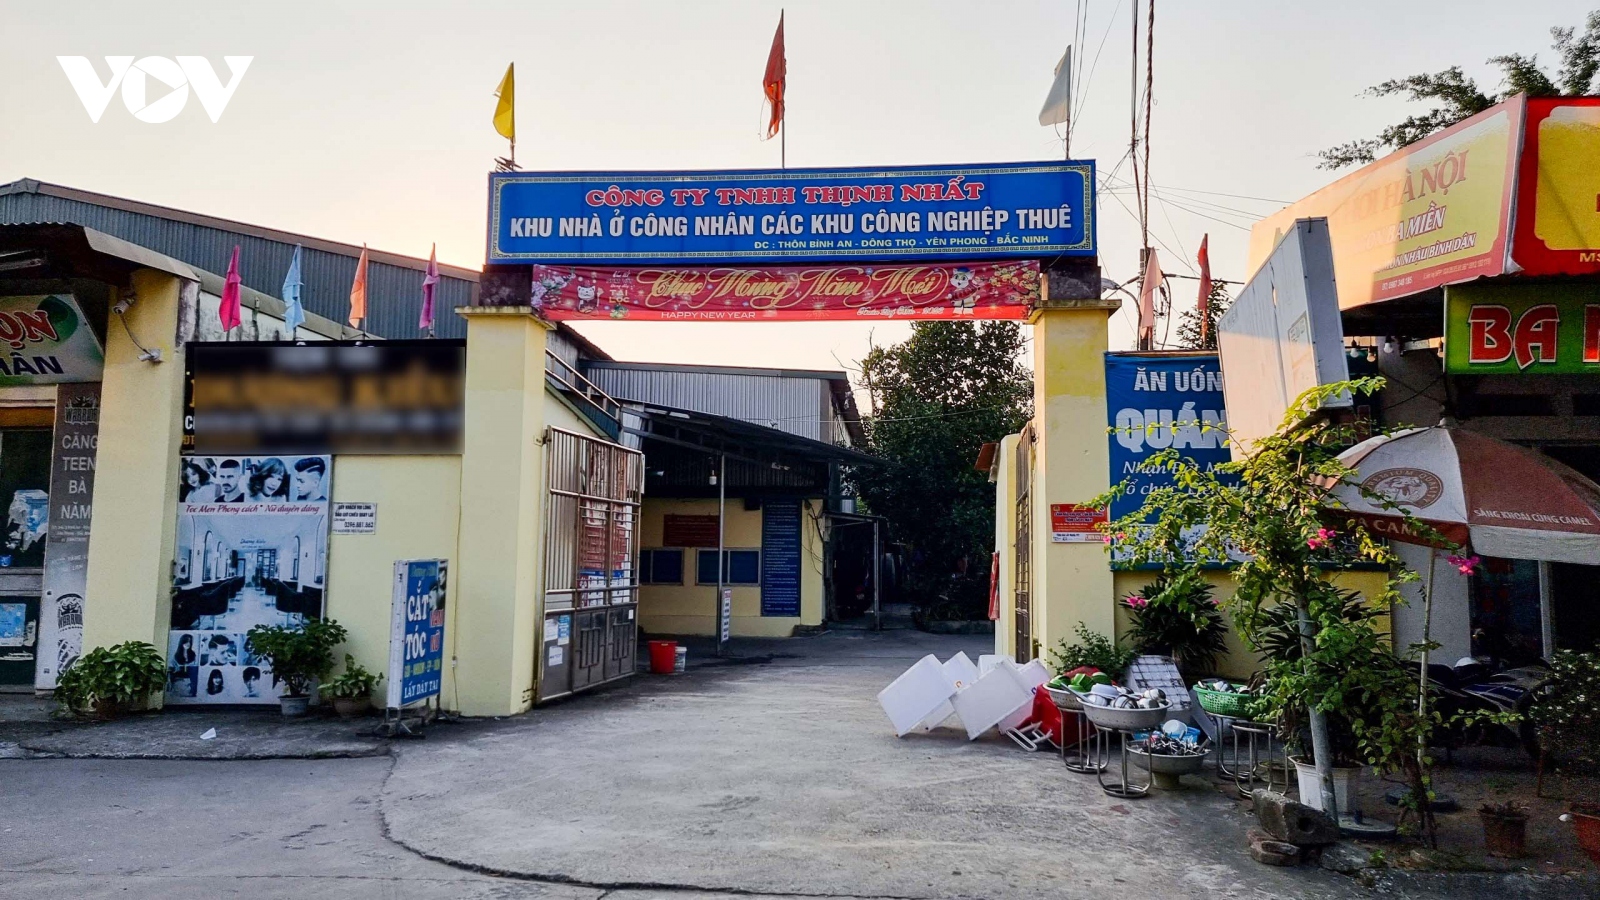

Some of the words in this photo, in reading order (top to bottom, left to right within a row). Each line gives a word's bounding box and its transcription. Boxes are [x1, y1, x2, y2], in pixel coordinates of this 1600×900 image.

[1418, 149, 1470, 199] NỘI
[586, 184, 665, 207] CÔNG
[671, 189, 709, 206] TY
[716, 187, 796, 206] TNHH
[802, 186, 894, 206] THỊNH
[901, 175, 984, 201] NHẤT
[510, 217, 552, 237] KHU
[559, 212, 602, 237] NHÀ
[610, 209, 625, 236] Ở
[630, 212, 687, 236] CÔNG
[695, 211, 754, 236] NHÂN
[761, 211, 804, 236] CÁC
[811, 213, 854, 235] KHU
[862, 209, 920, 234] CÔNG
[928, 206, 1008, 234] NGHIỆP
[1016, 204, 1072, 229] THUÊ
[1404, 200, 1446, 240] MIỀN
[778, 239, 806, 249] THÔN
[809, 239, 834, 249] BÌNH
[837, 240, 852, 248] AN
[895, 239, 916, 248] THỌ
[925, 237, 946, 247] YÊN
[950, 237, 988, 247] PHONG
[997, 235, 1019, 245] BẮC
[1022, 236, 1048, 244] NINH
[1430, 240, 1455, 260] BÌNH
[1454, 231, 1477, 253] DÂN
[636, 269, 708, 308] Chúc
[686, 268, 801, 309] Mừng
[790, 267, 872, 308] Năm
[844, 266, 949, 308] Mới
[1468, 303, 1560, 371] BA
[1133, 366, 1167, 392] ĂN
[1115, 401, 1231, 453] QUÁN
[62, 457, 96, 471] TEEN
[69, 477, 87, 495] BÀ
[60, 502, 92, 520] NĂM
[407, 580, 429, 622] CẮT
[405, 624, 427, 660] TÓC
